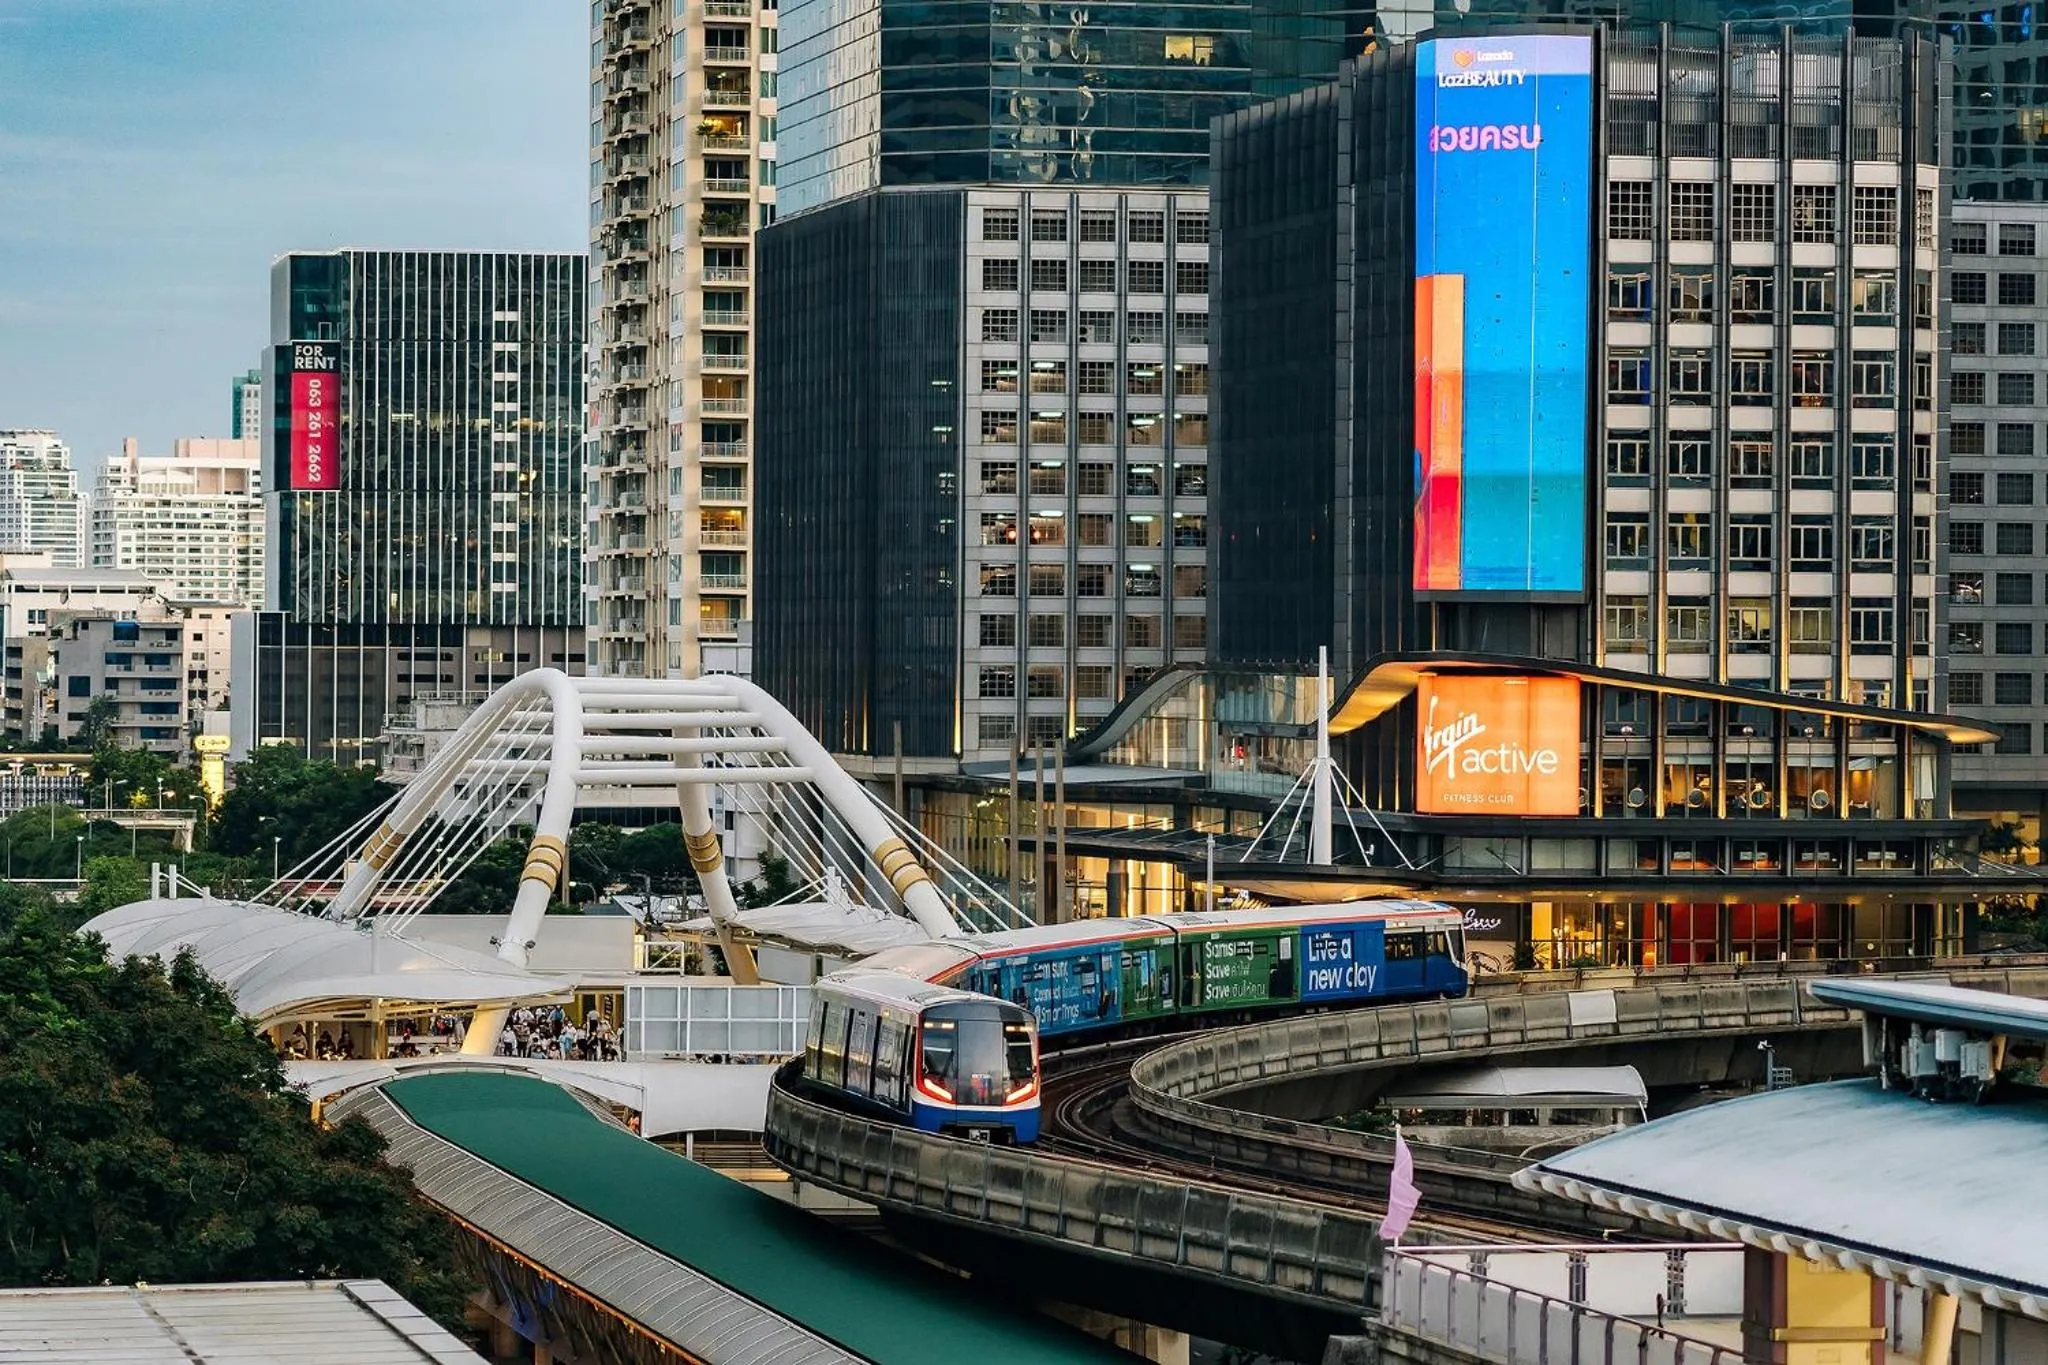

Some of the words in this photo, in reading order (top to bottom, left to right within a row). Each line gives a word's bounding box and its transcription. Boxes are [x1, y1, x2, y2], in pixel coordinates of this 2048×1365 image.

[1438, 69, 1526, 87] LazBEAUTY
[294, 357, 336, 369] RENT
[295, 345, 323, 356] FOR
[309, 379, 322, 407] 063
[308, 412, 322, 438] 261
[307, 445, 322, 483] 2662
[1424, 695, 1487, 780] Virgin
[1461, 742, 1558, 774] active
[1443, 793, 1484, 804] FITNESS
[1308, 934, 1338, 961] Live
[1341, 938, 1352, 959] a
[1206, 963, 1231, 979] Save
[1308, 967, 1343, 991] new
[1346, 962, 1377, 993] day
[1205, 983, 1230, 1000] Save
